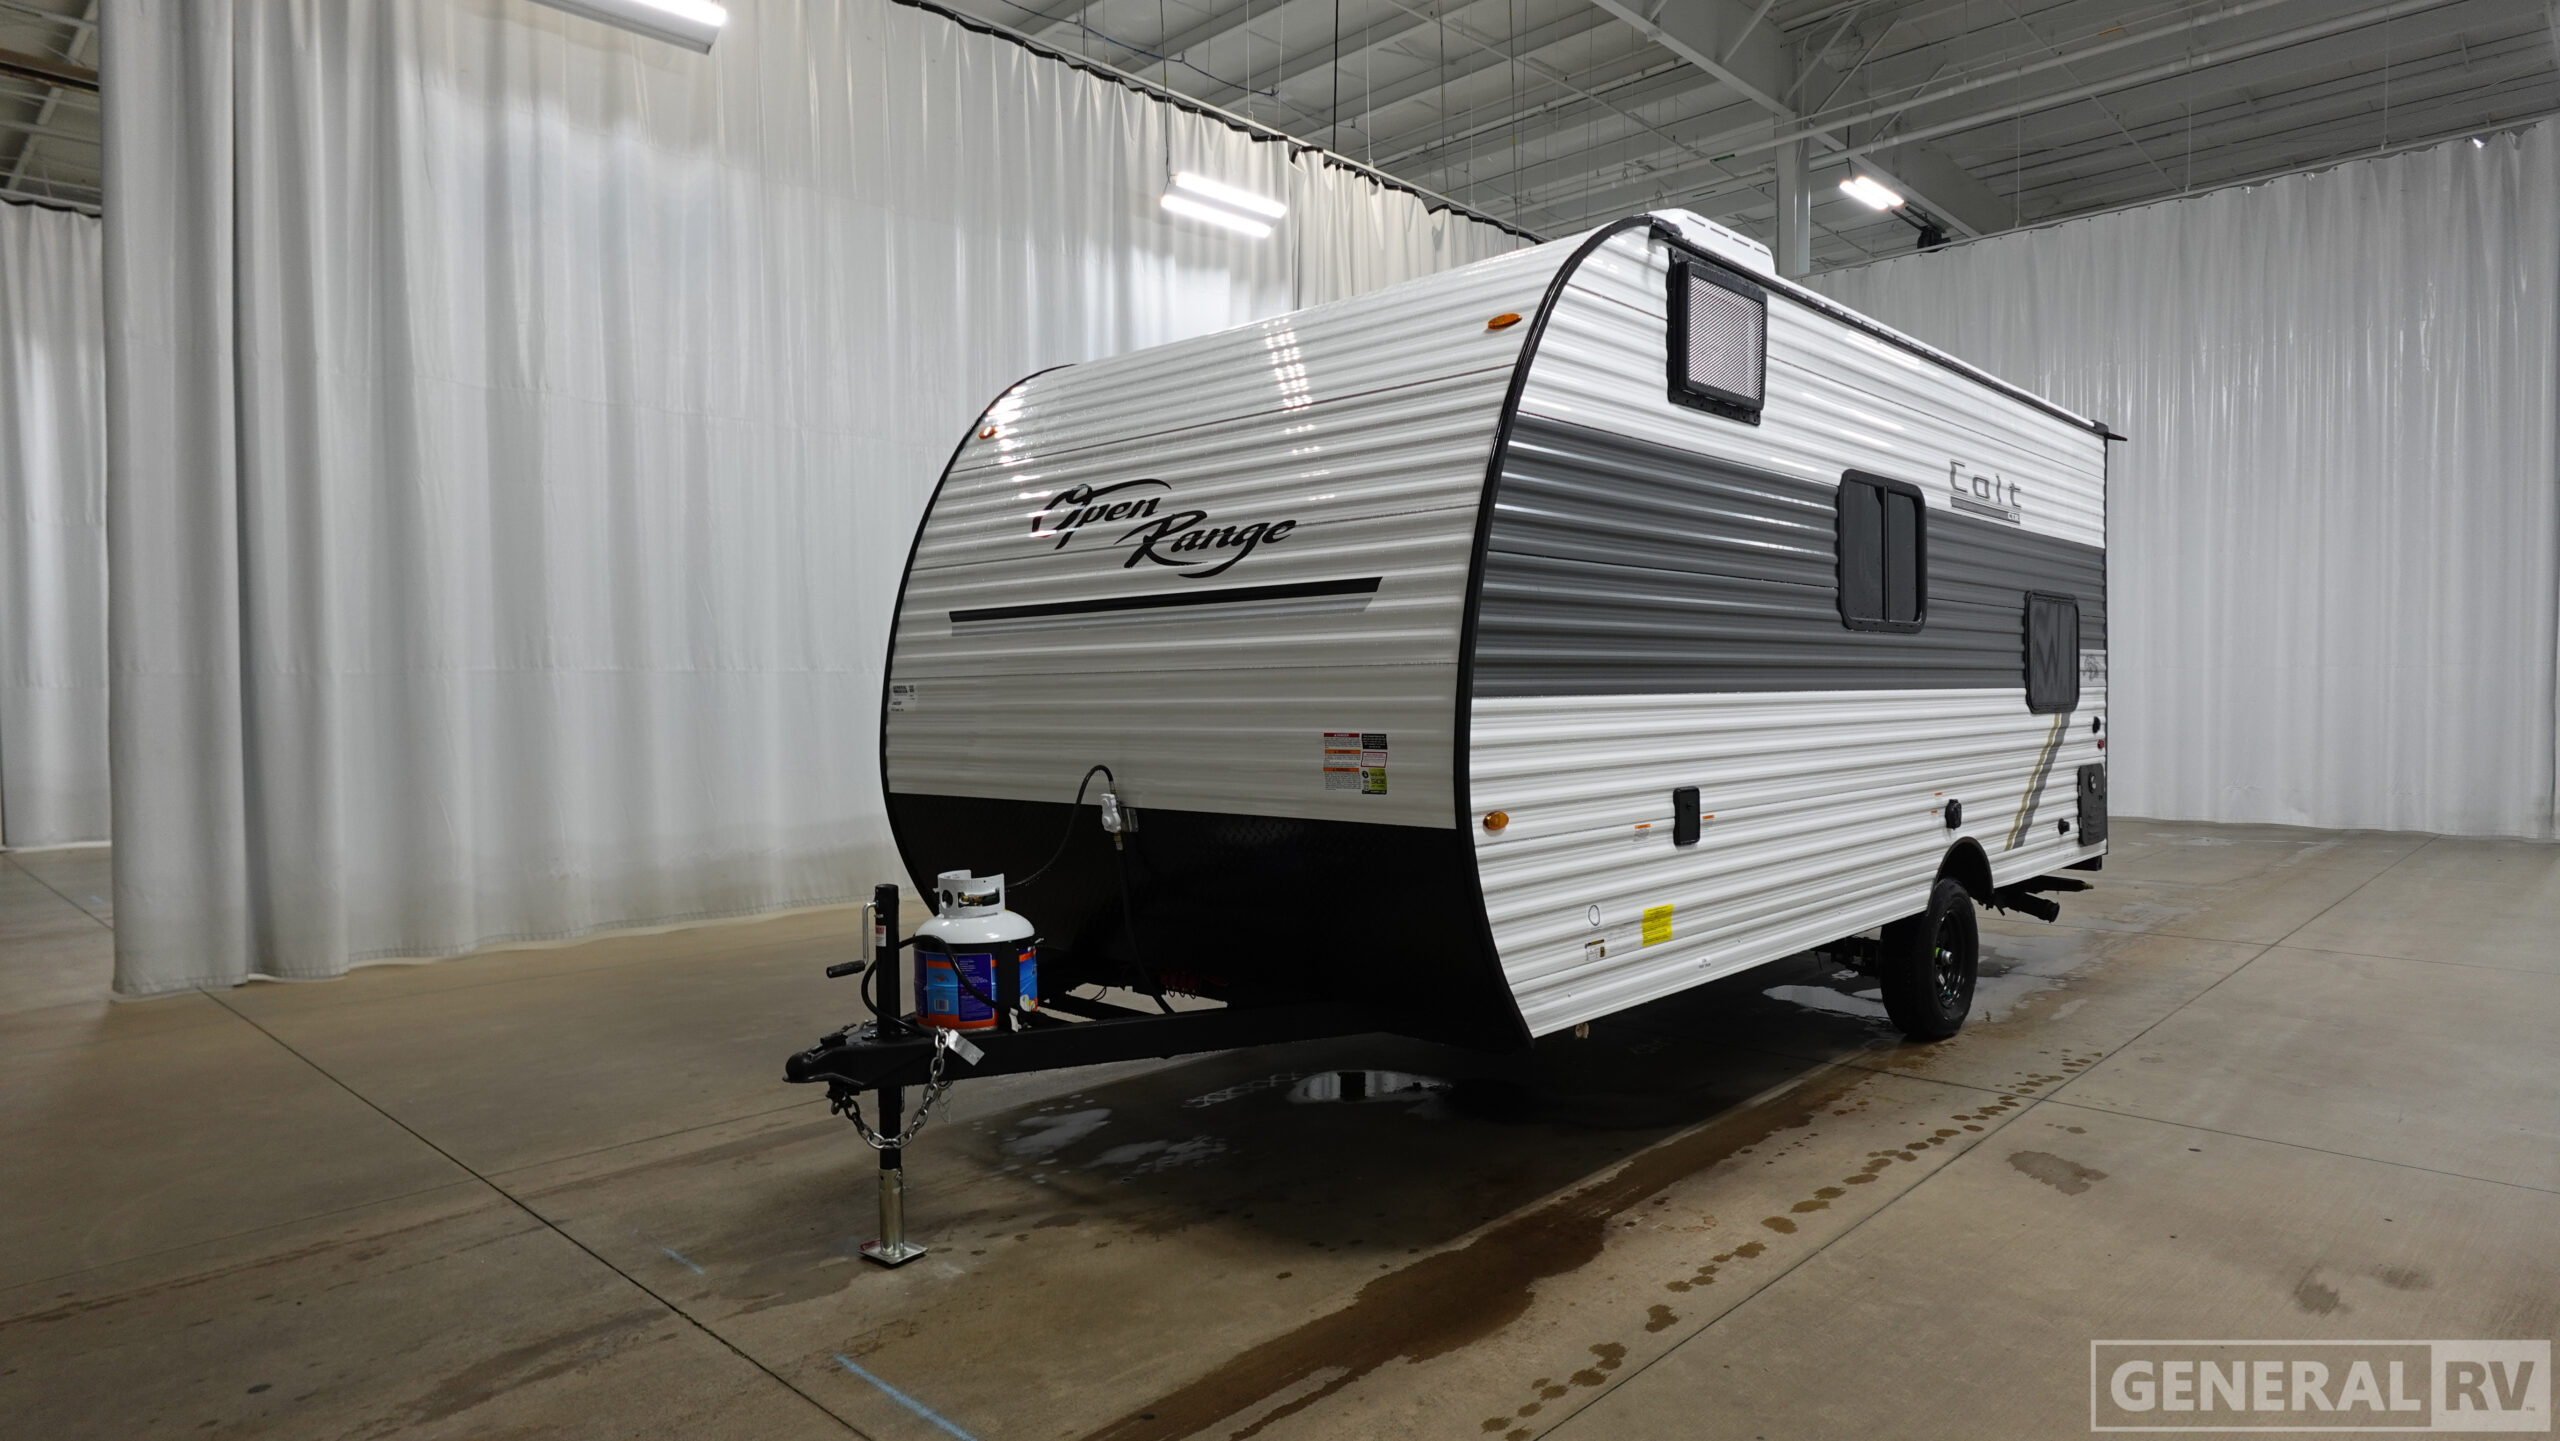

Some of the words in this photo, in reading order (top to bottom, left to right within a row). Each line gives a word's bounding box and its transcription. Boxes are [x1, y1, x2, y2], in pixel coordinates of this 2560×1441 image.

[1031, 478, 1172, 550] Open
[1949, 460, 2022, 508] Colt
[1113, 510, 1297, 578] Range
